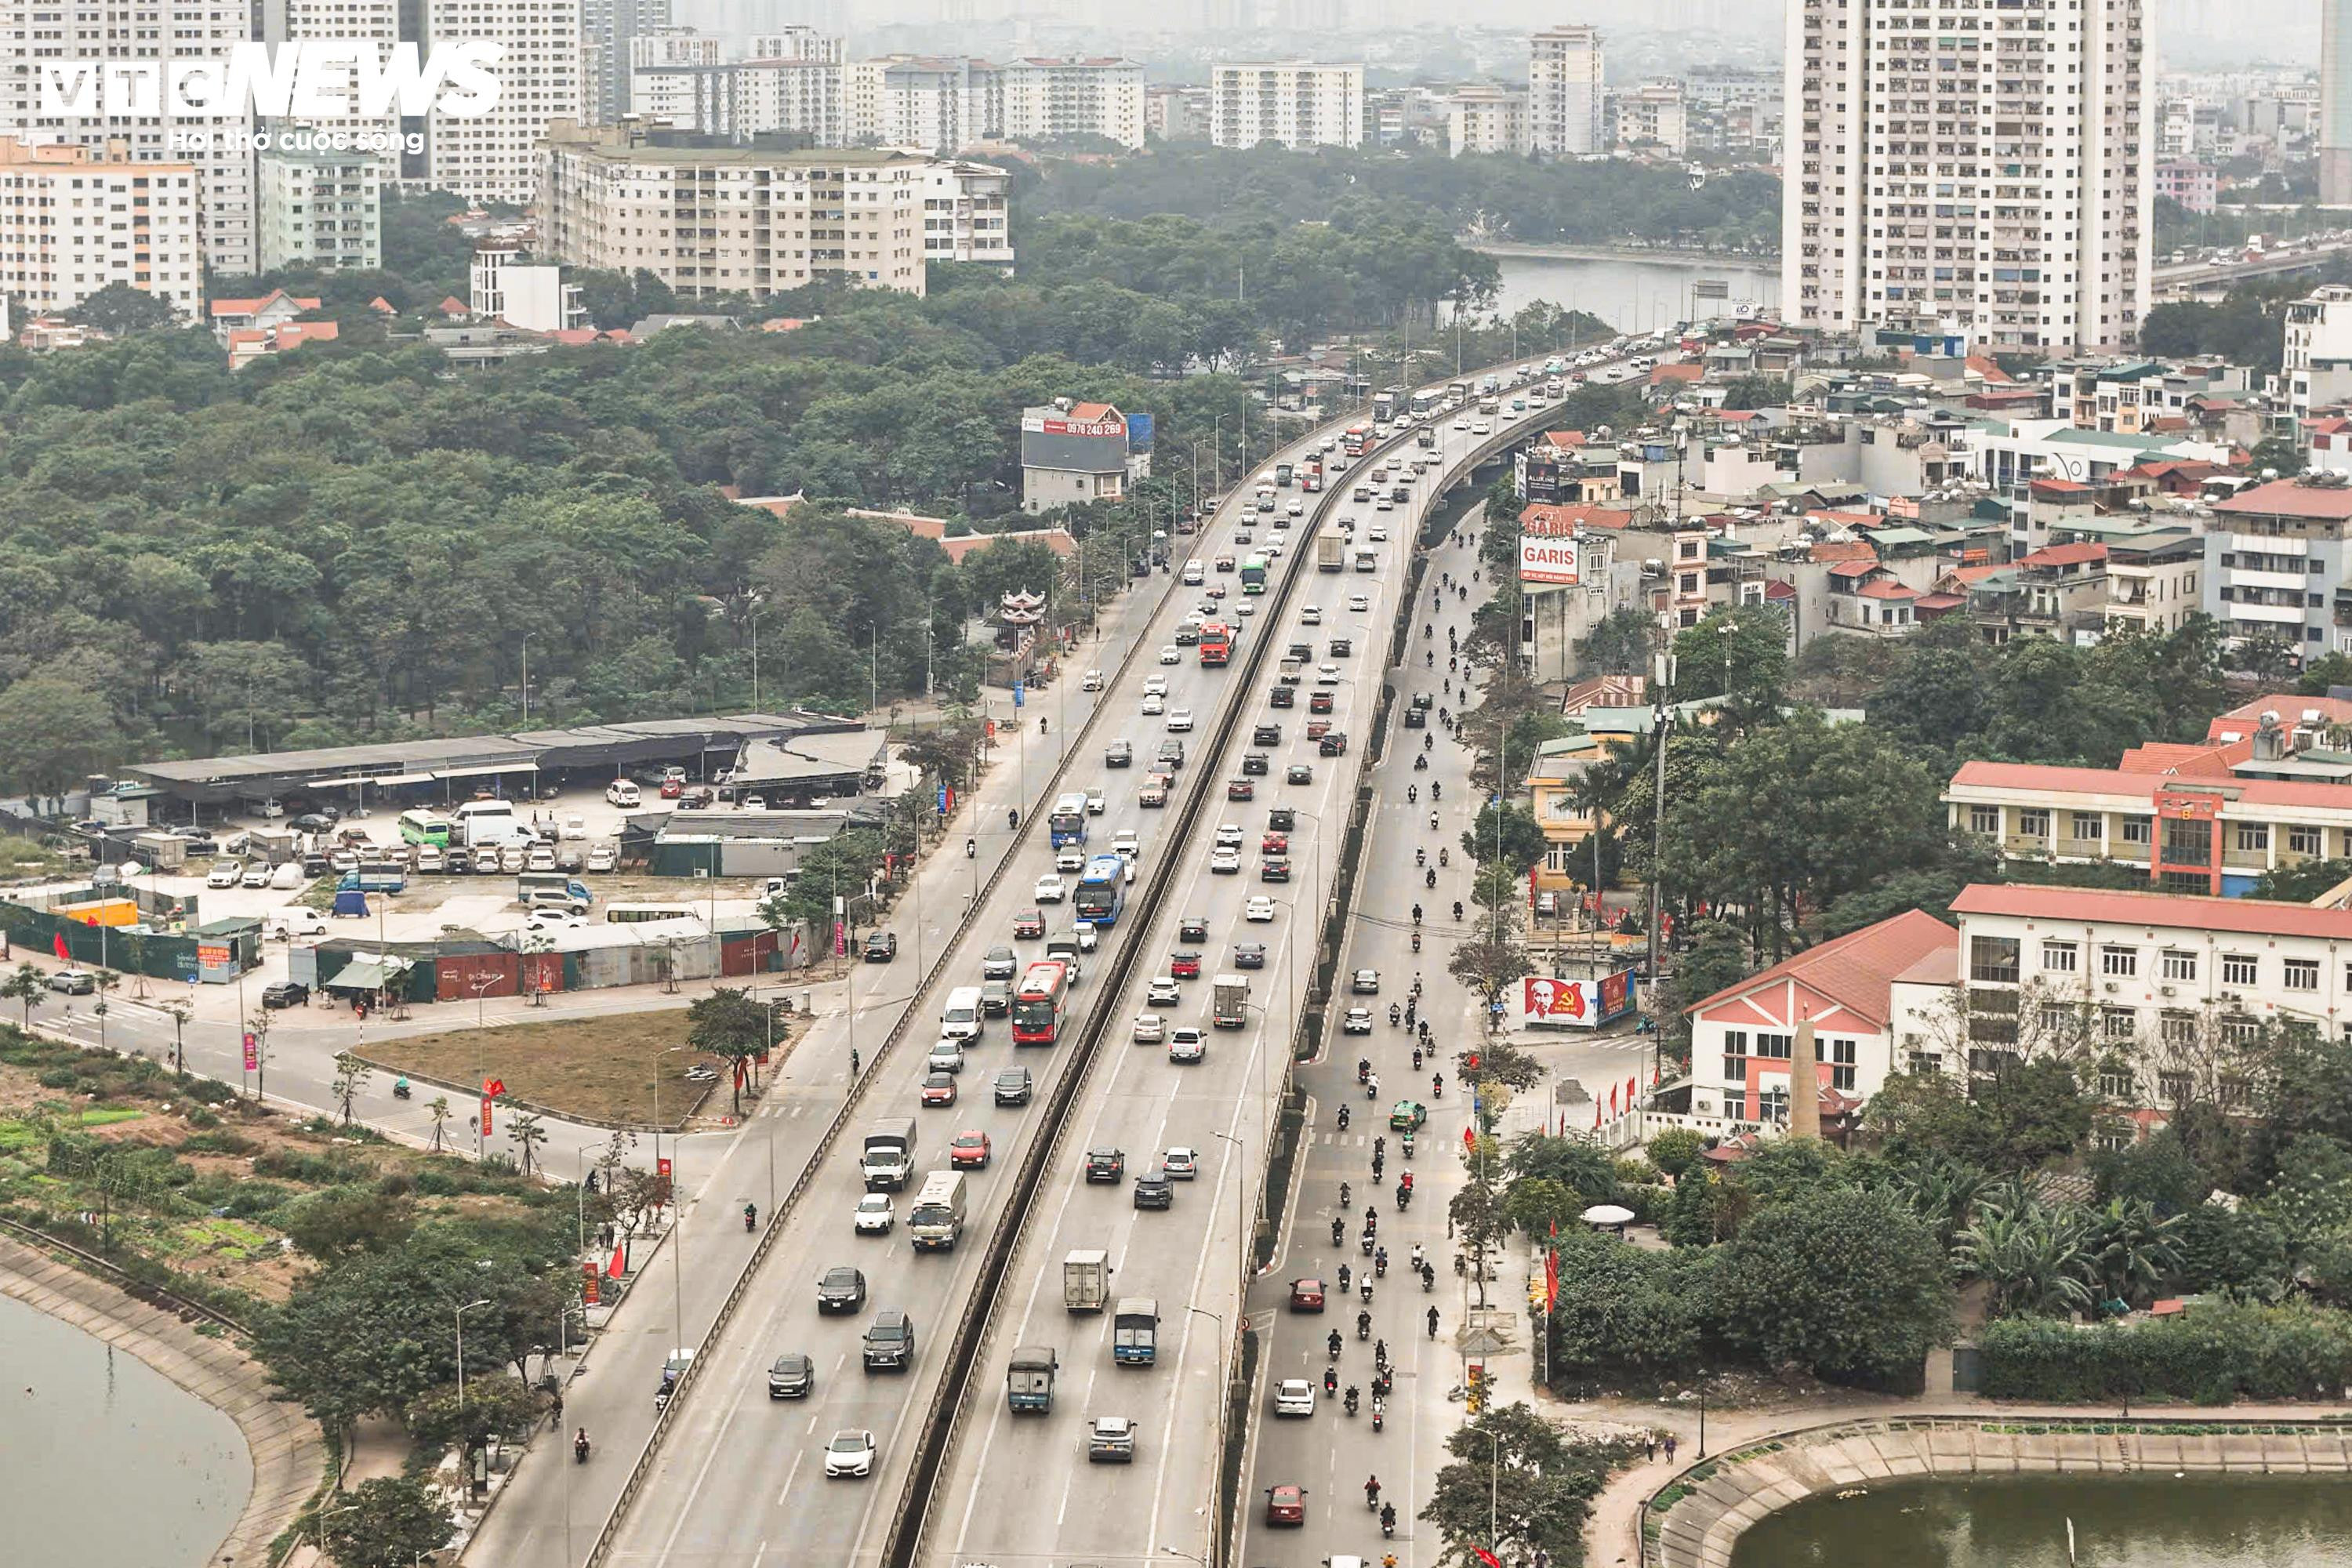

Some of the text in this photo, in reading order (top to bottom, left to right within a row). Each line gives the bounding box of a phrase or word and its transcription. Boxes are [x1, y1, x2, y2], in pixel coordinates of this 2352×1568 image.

[1087, 424, 1102, 435] 240
[1525, 520, 1573, 537] GARIS
[1524, 547, 1574, 565] GARIS
